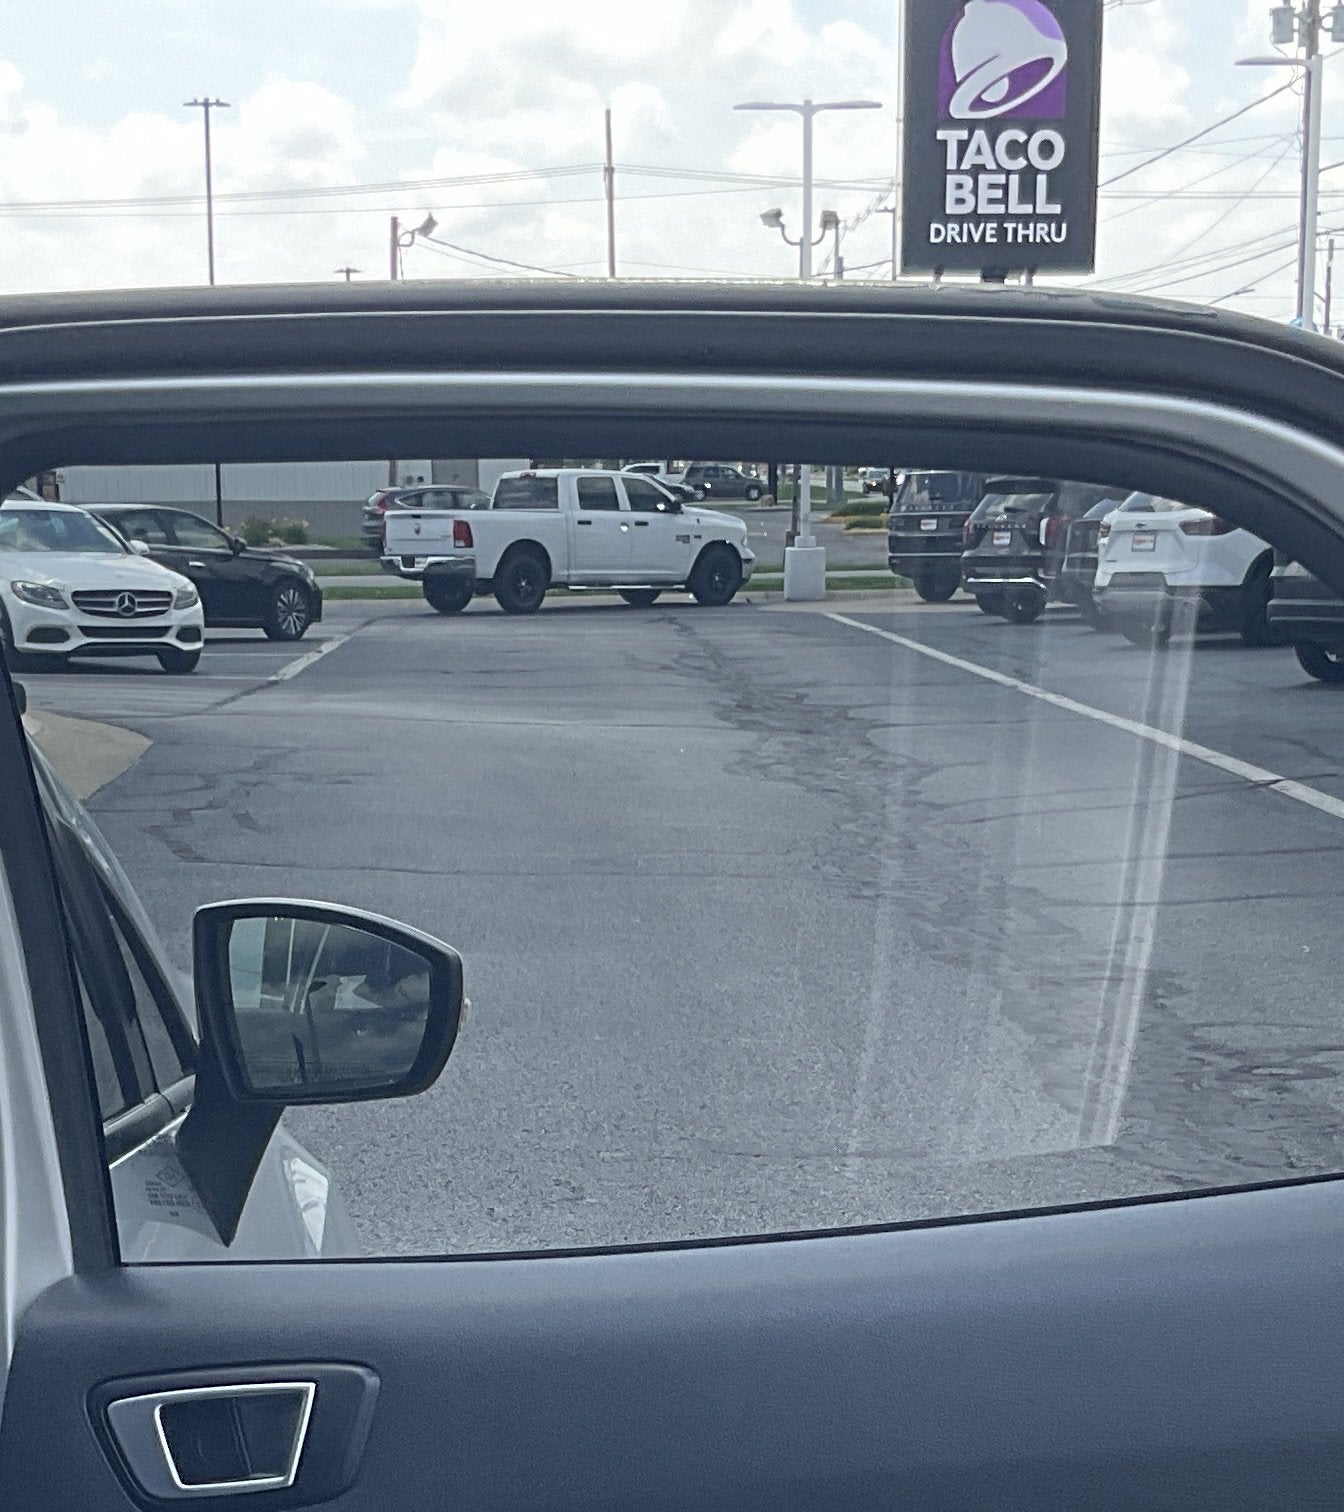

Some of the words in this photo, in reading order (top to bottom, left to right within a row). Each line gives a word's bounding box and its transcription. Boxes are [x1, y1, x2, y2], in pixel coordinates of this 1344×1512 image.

[936, 128, 1065, 170] TACO
[945, 173, 1062, 214] BELL
[929, 222, 998, 243] DRIVE
[1003, 222, 1067, 243] THRU
